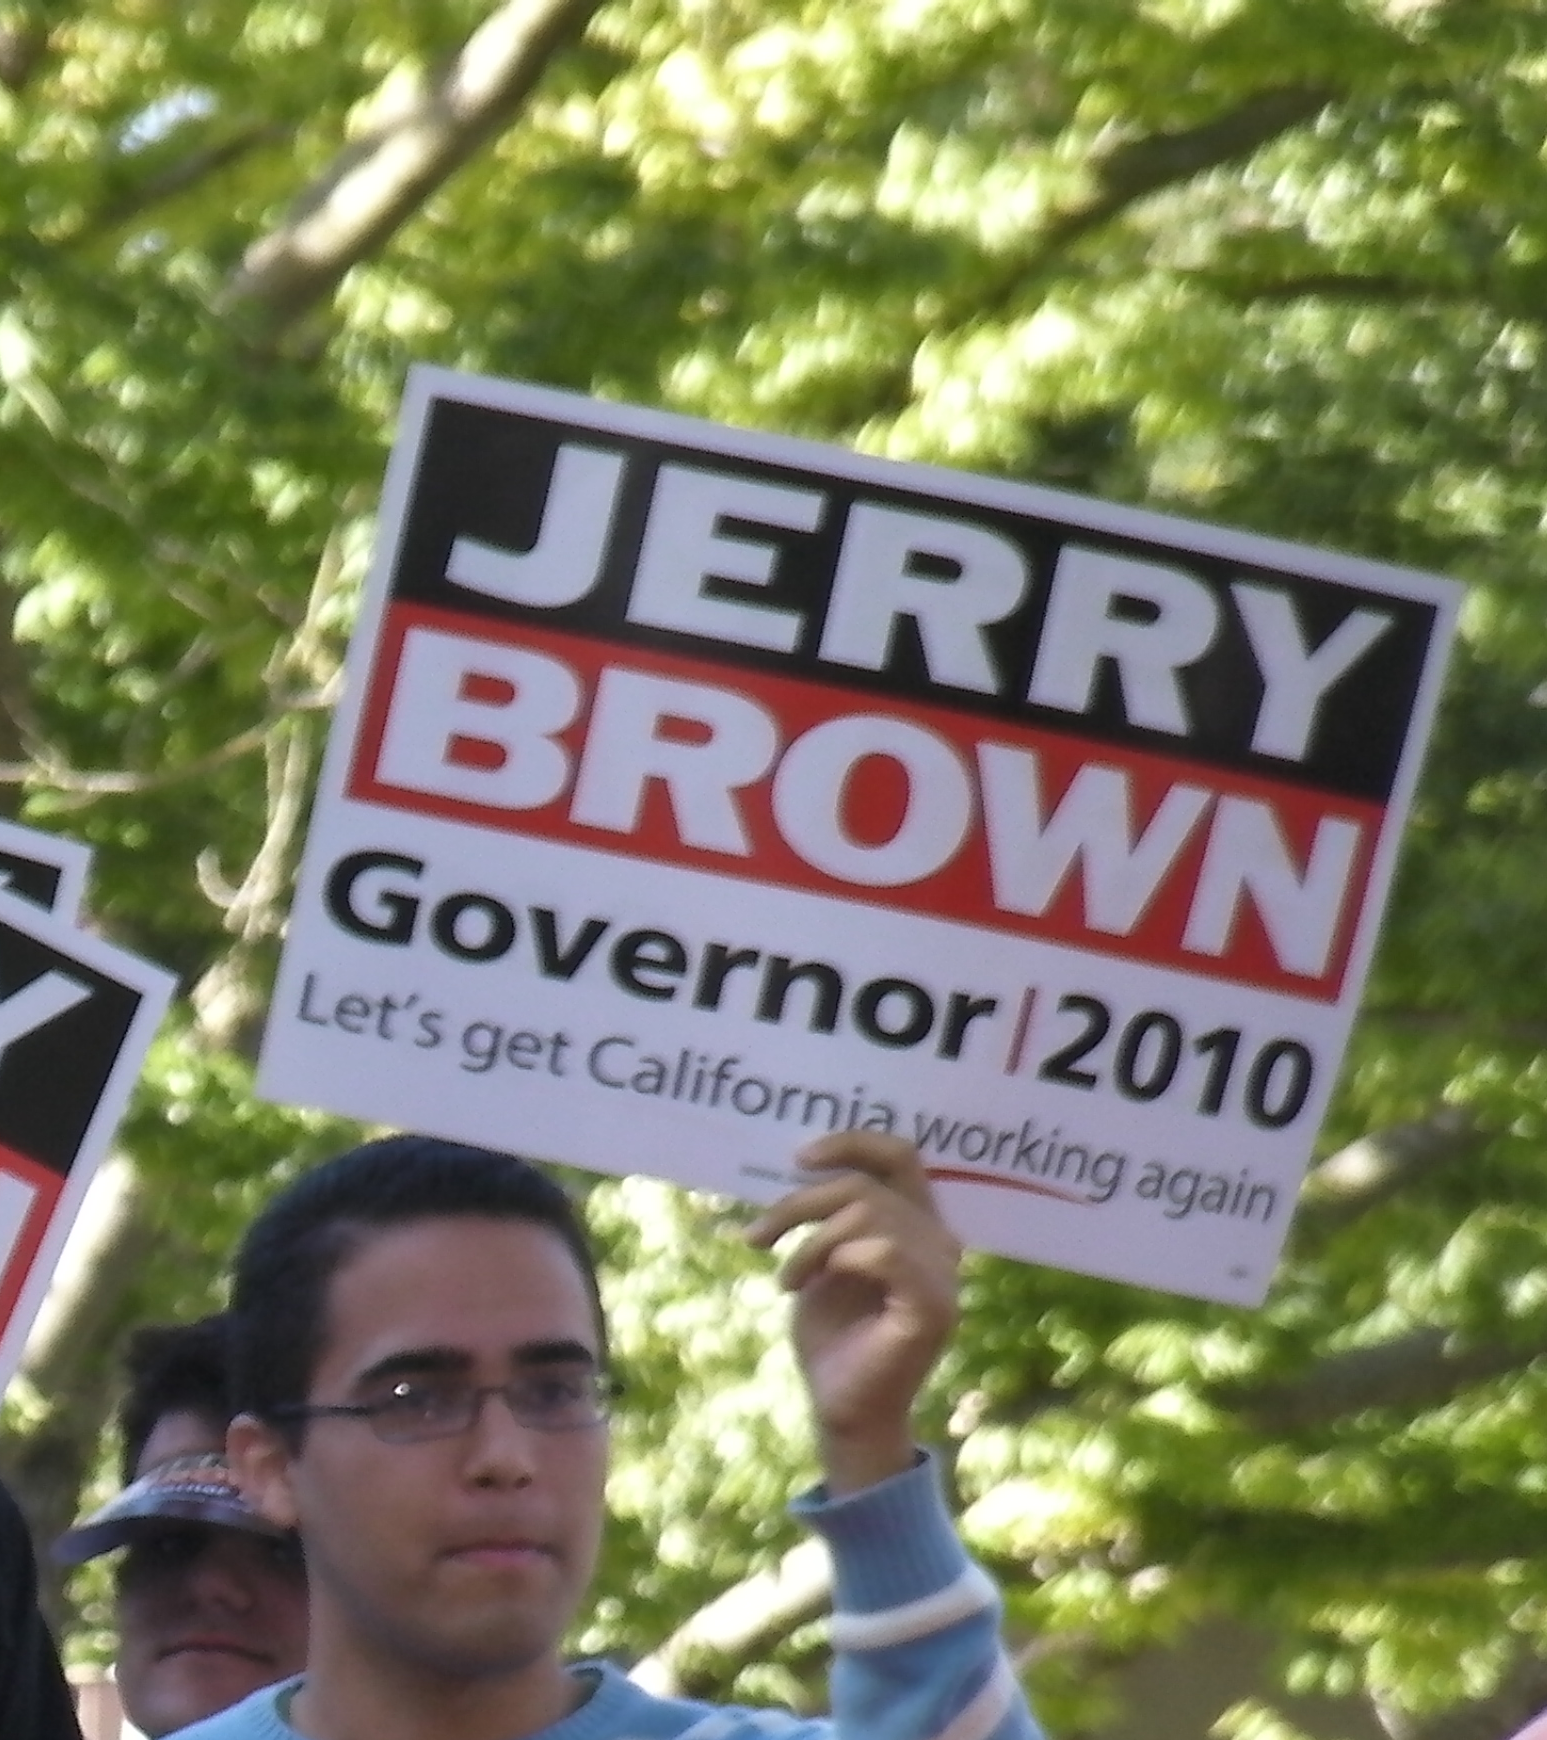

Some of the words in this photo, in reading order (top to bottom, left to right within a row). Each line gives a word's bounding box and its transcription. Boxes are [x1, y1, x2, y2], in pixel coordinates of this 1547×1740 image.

[445, 442, 1392, 762] JERRY
[372, 625, 1364, 979] BROWN
[296, 974, 449, 1050] Let's
[459, 1022, 574, 1086] get
[587, 1036, 898, 1140] California
[910, 1102, 1127, 1204] working
[1135, 1158, 1278, 1223] again
[322, 849, 995, 1063] Governor
[1038, 995, 1312, 1130] 2010
